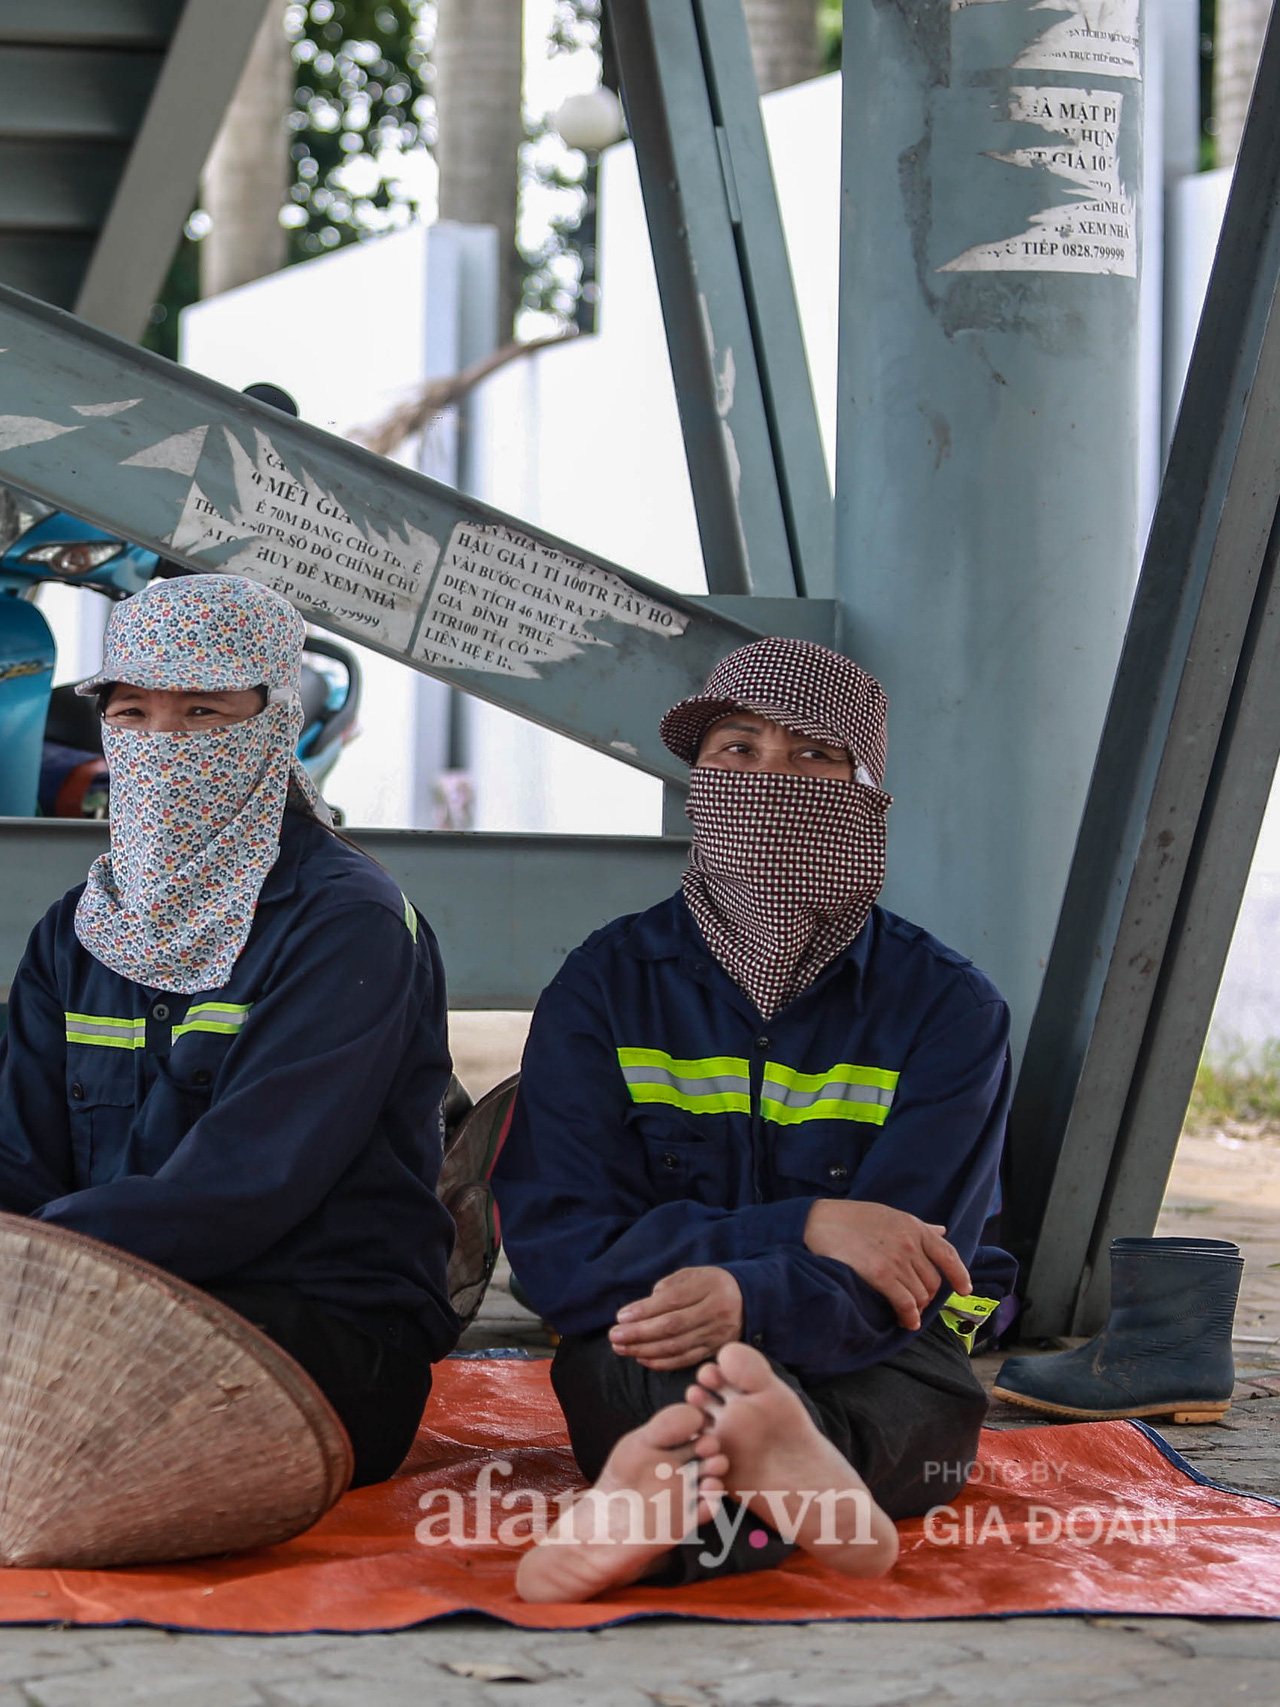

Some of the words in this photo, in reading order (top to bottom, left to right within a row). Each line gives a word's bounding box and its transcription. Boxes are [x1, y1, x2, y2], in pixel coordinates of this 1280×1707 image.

[1078, 220, 1107, 237] XEM
[270, 505, 299, 527] 70M
[299, 517, 344, 544] ĐANG
[345, 536, 380, 558] CHO
[335, 552, 385, 581] CHÍNH
[496, 548, 527, 570] GIÁ
[530, 561, 539, 575] 1
[562, 574, 609, 603] 100TR
[612, 592, 647, 616] TÂY
[320, 570, 361, 596] XEM
[361, 585, 397, 611] NHÀ
[437, 592, 462, 612] GIA
[452, 554, 477, 574] VÀI
[521, 582, 564, 607] CHÂN
[564, 598, 583, 617] RA
[482, 588, 517, 612] TÍCH
[518, 605, 533, 619] 46
[431, 610, 479, 637] 1TR100
[424, 626, 460, 649] LIÊN
[483, 649, 495, 663] E
